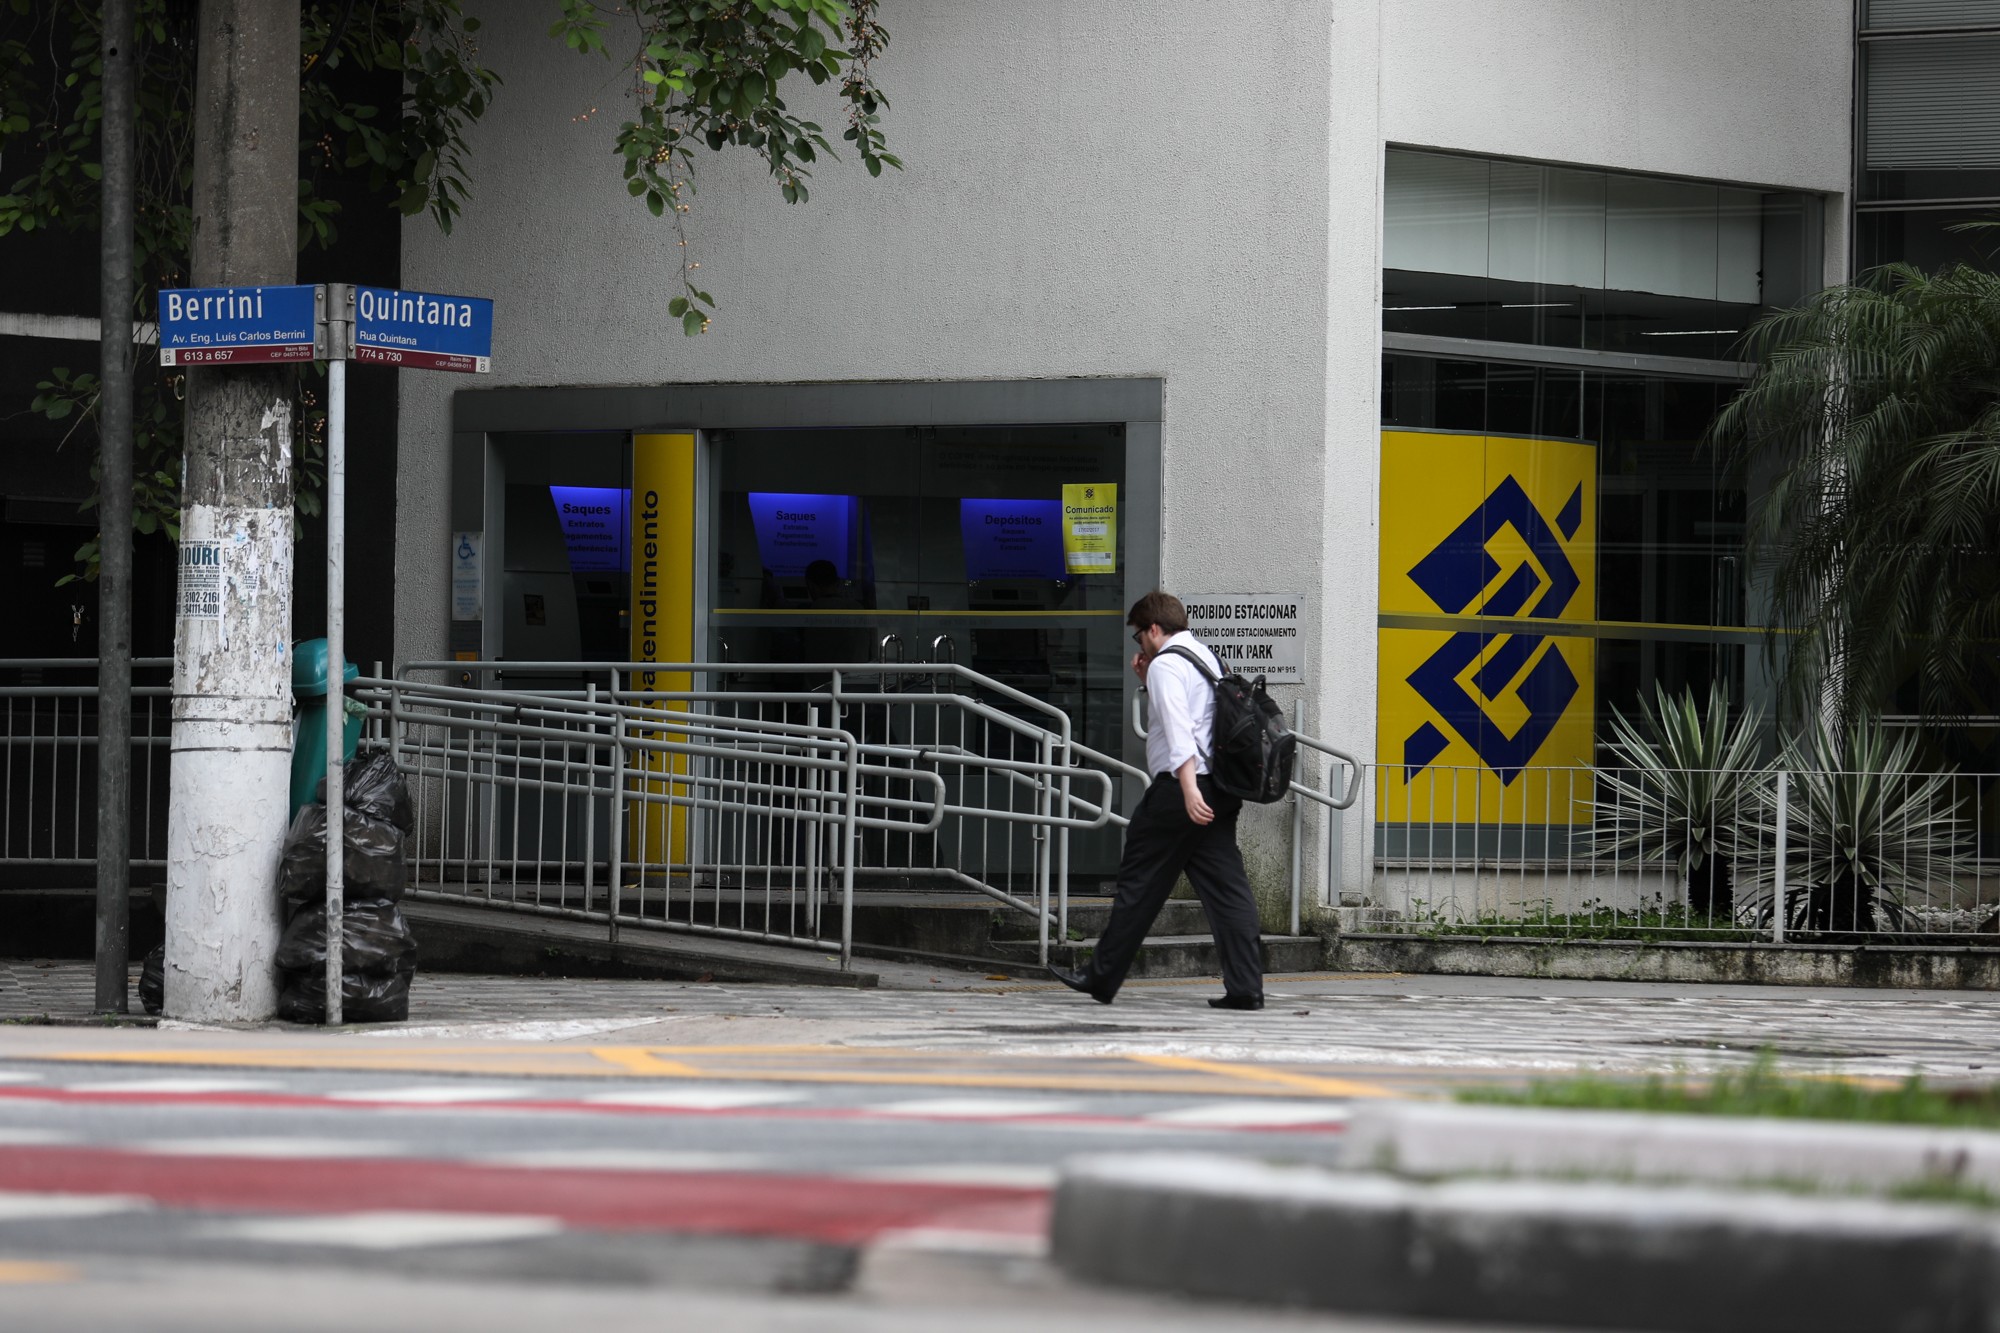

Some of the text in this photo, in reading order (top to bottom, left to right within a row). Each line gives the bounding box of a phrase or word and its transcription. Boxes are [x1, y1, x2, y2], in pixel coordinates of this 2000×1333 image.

[168, 288, 263, 322] Berrini
[360, 291, 472, 327] Quintana
[172, 329, 306, 344] Av. Eng. Luís Carlos Berrini
[360, 330, 417, 346] Rua Quintana
[165, 354, 171, 363] 8
[184, 350, 234, 361] 613 a 657
[360, 348, 402, 362] 774 a 730
[480, 363, 486, 371] 8
[562, 503, 611, 516] Saques
[776, 511, 816, 522] Saques
[1066, 505, 1114, 514] Comunicado
[568, 520, 606, 528] Extratos
[985, 514, 1042, 528] Depósitos
[1186, 604, 1297, 619] PROIBIDO ESTACIONAR
[639, 490, 659, 762] Auoatendimento
[1221, 628, 1235, 637] COM
[1237, 628, 1297, 637] ESTACIONAMENTO
[1246, 644, 1273, 659] PARK
